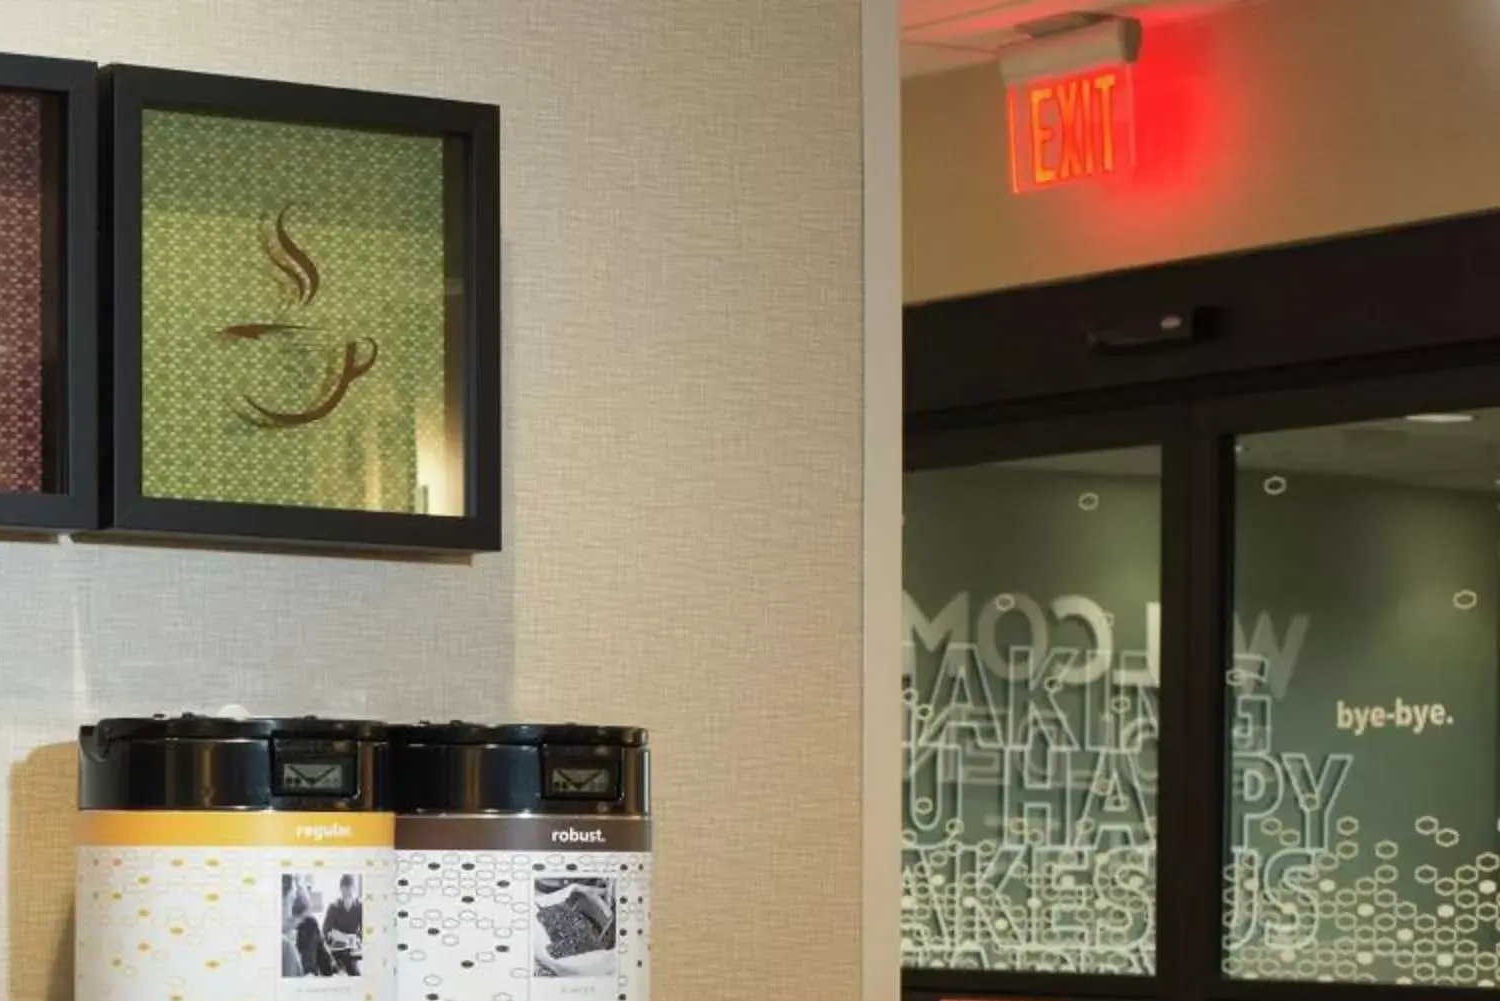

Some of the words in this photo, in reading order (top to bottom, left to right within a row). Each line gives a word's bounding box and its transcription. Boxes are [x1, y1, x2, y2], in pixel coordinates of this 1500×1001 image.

[1030, 74, 1116, 184] EXIT
[1336, 697, 1454, 736] bye-bye.
[551, 827, 607, 843] robust.
